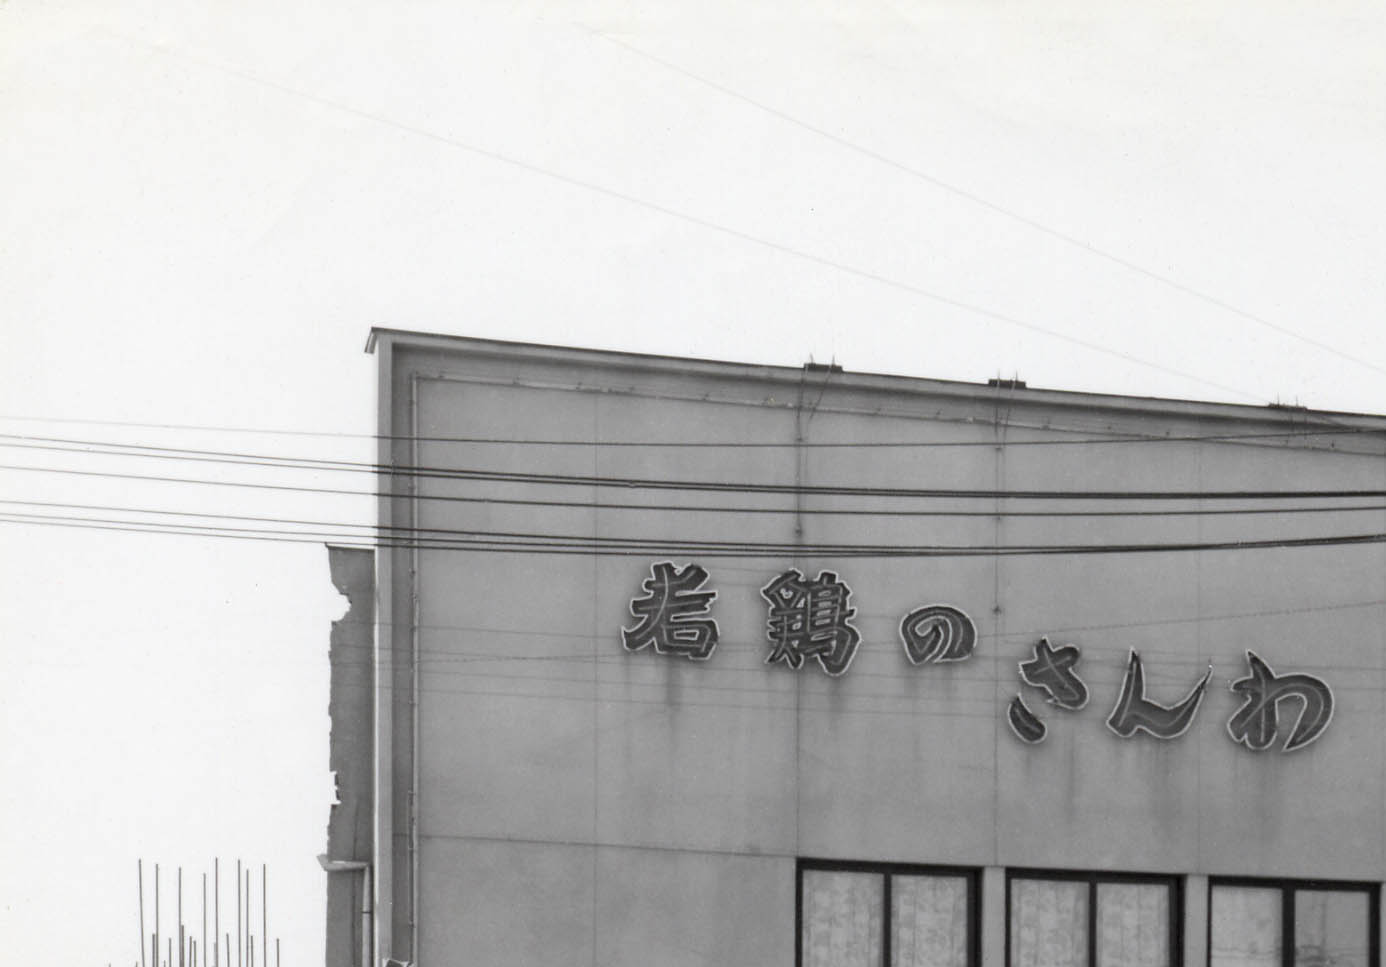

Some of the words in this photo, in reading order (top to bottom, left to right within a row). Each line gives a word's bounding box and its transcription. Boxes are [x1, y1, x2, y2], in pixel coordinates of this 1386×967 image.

[621, 561, 978, 677] 若鶏の
[1008, 636, 1335, 753] さんわ
